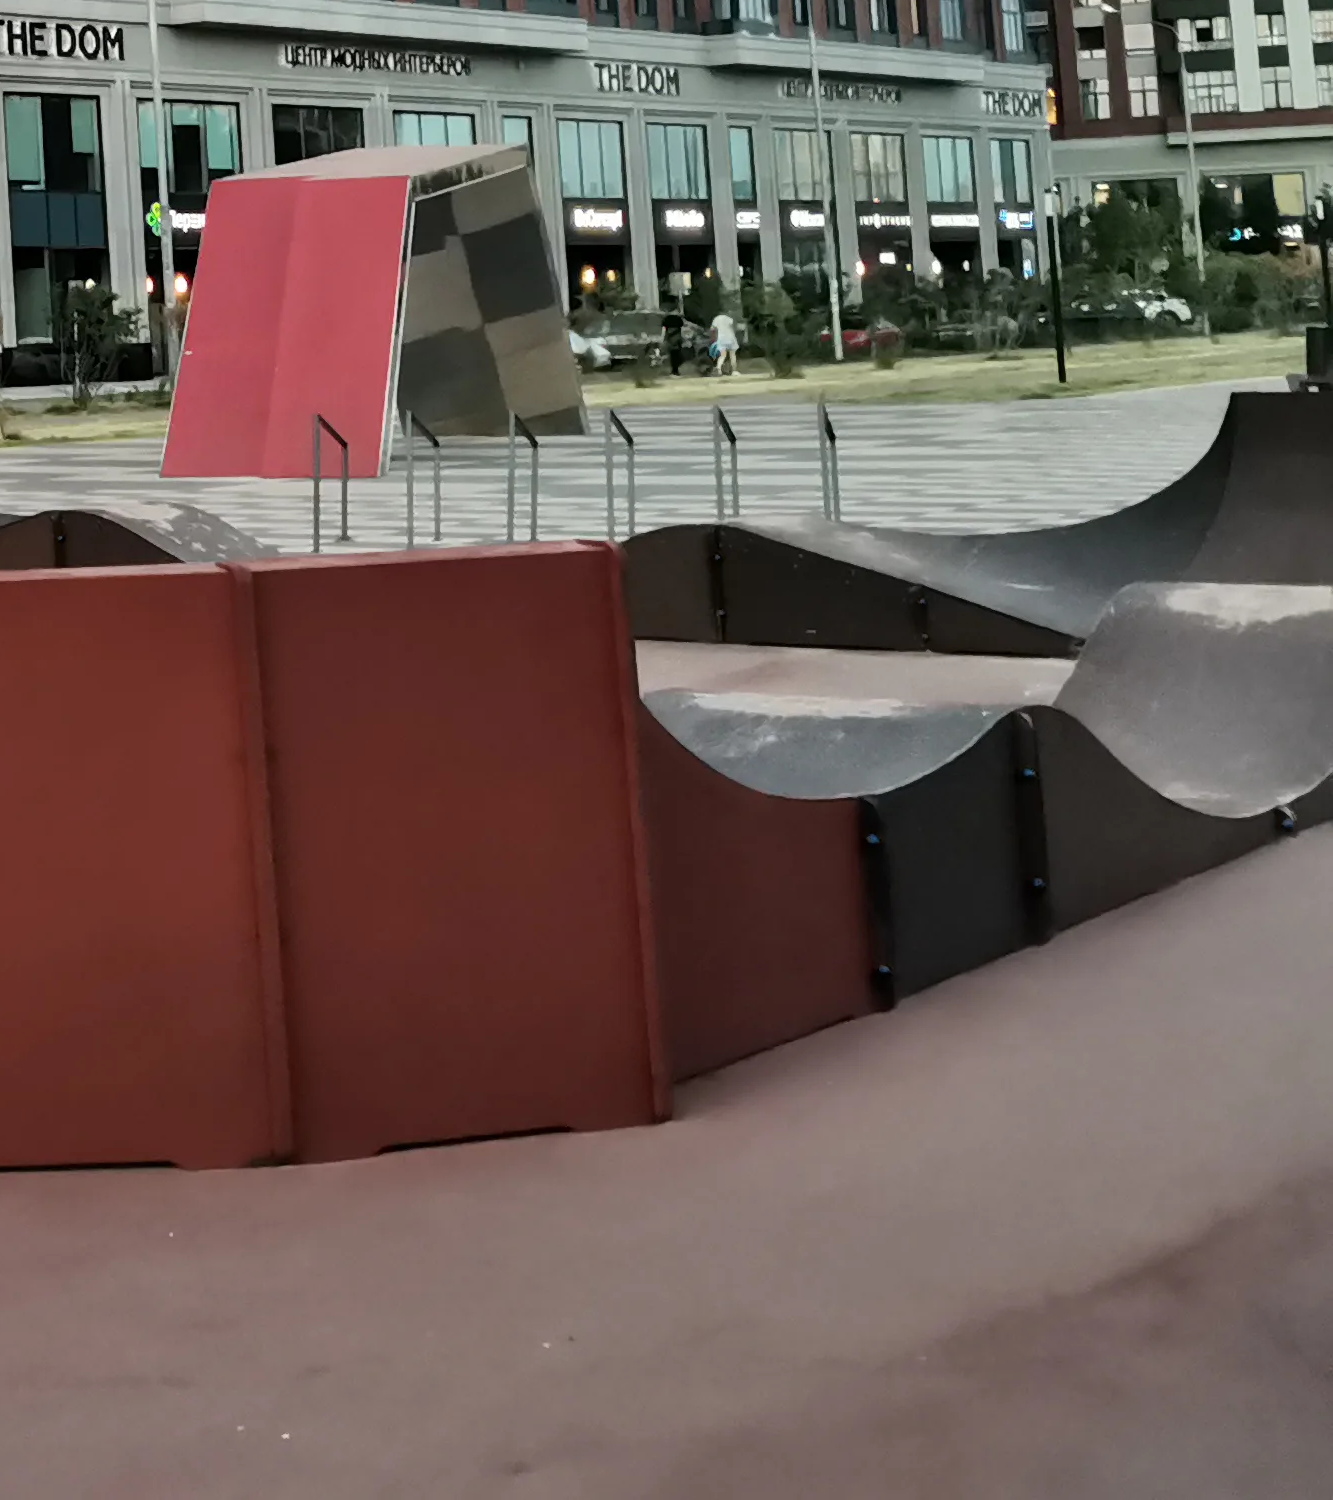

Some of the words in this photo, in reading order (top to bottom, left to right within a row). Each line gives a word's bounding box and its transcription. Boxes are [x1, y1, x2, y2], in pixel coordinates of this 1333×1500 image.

[55, 23, 125, 61] DOM
[284, 45, 330, 68] ЦЕНТР
[594, 62, 633, 92] THE
[637, 66, 680, 96] DOM
[983, 90, 1010, 115] THE
[1012, 91, 1043, 117] DOM
